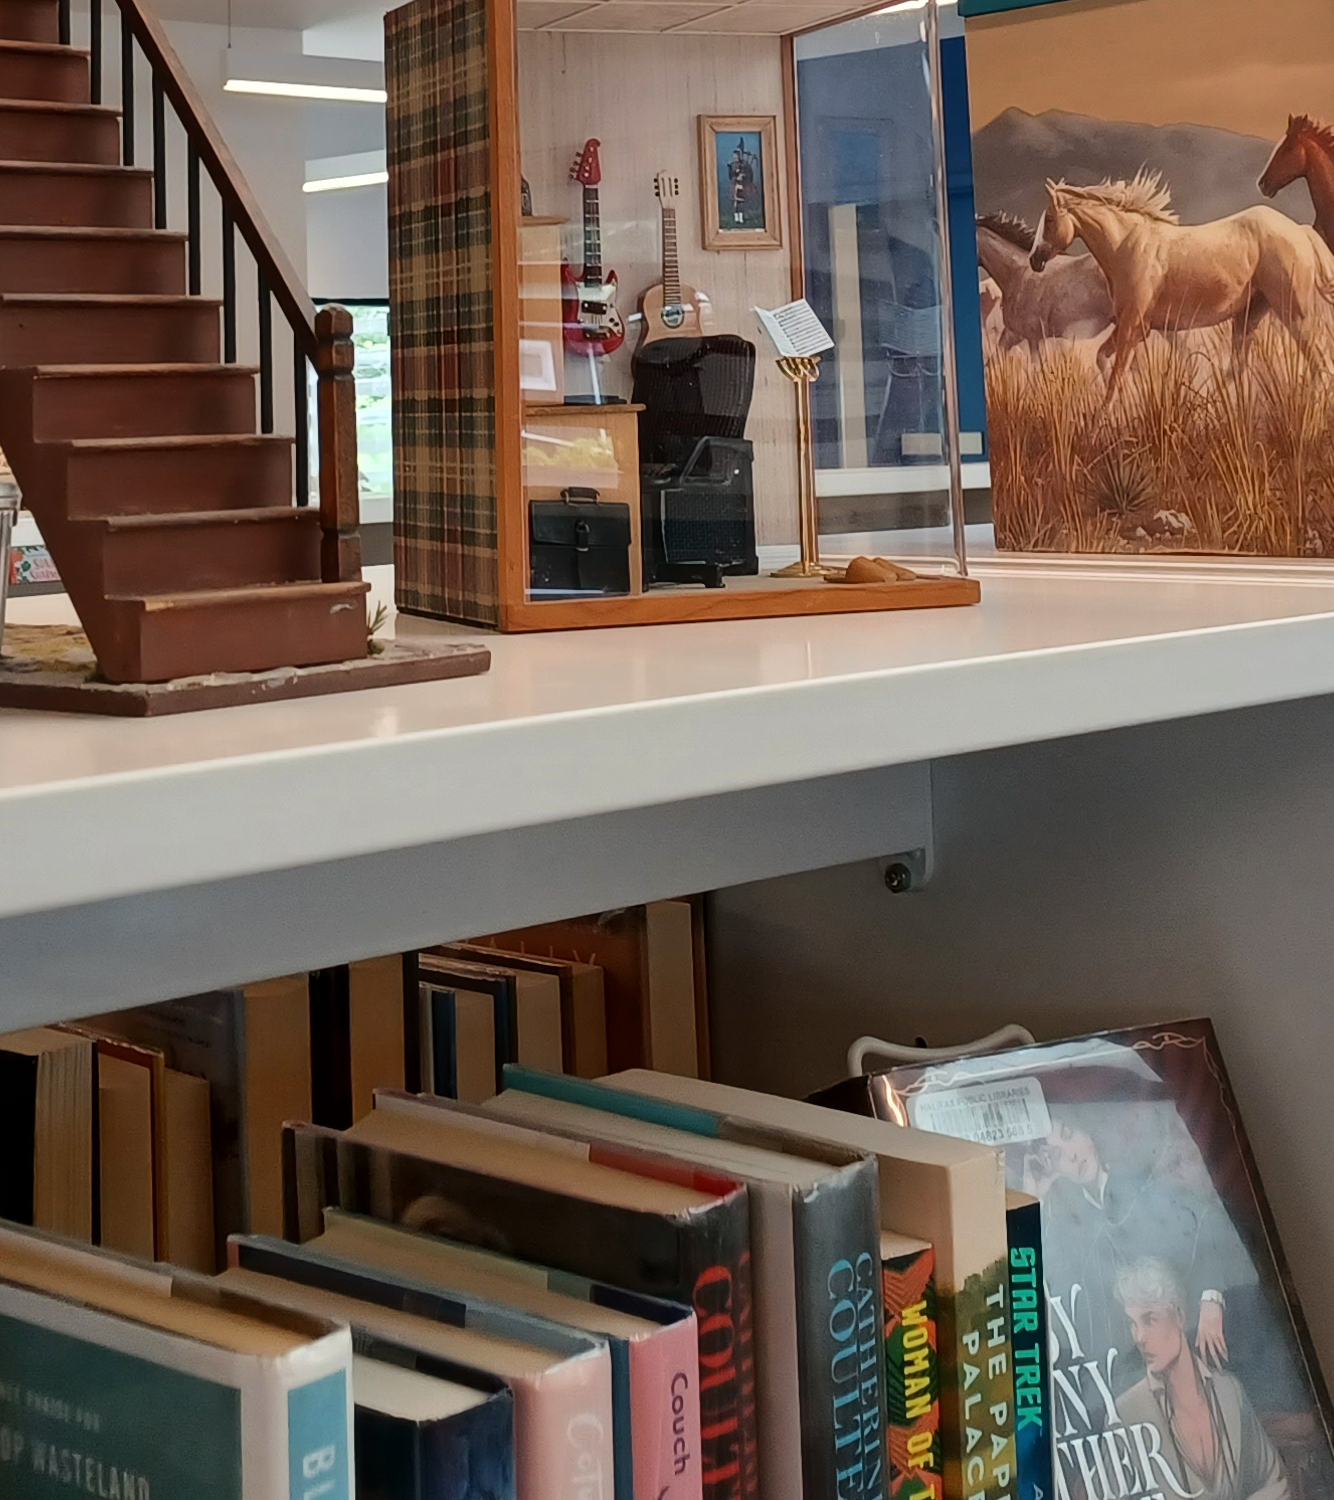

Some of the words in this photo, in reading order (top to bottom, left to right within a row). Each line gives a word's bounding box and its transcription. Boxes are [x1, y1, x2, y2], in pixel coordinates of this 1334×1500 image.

[988, 1086, 1031, 1102] LIBRARIES
[986, 1283, 1007, 1380] THE
[1010, 1246, 1038, 1334] STAR
[855, 1252, 884, 1500] CATHERIN
[901, 1300, 933, 1419] WOMAN
[1014, 1341, 1043, 1432] TREK
[670, 1371, 692, 1477] Couch
[907, 1431, 934, 1475] OF
